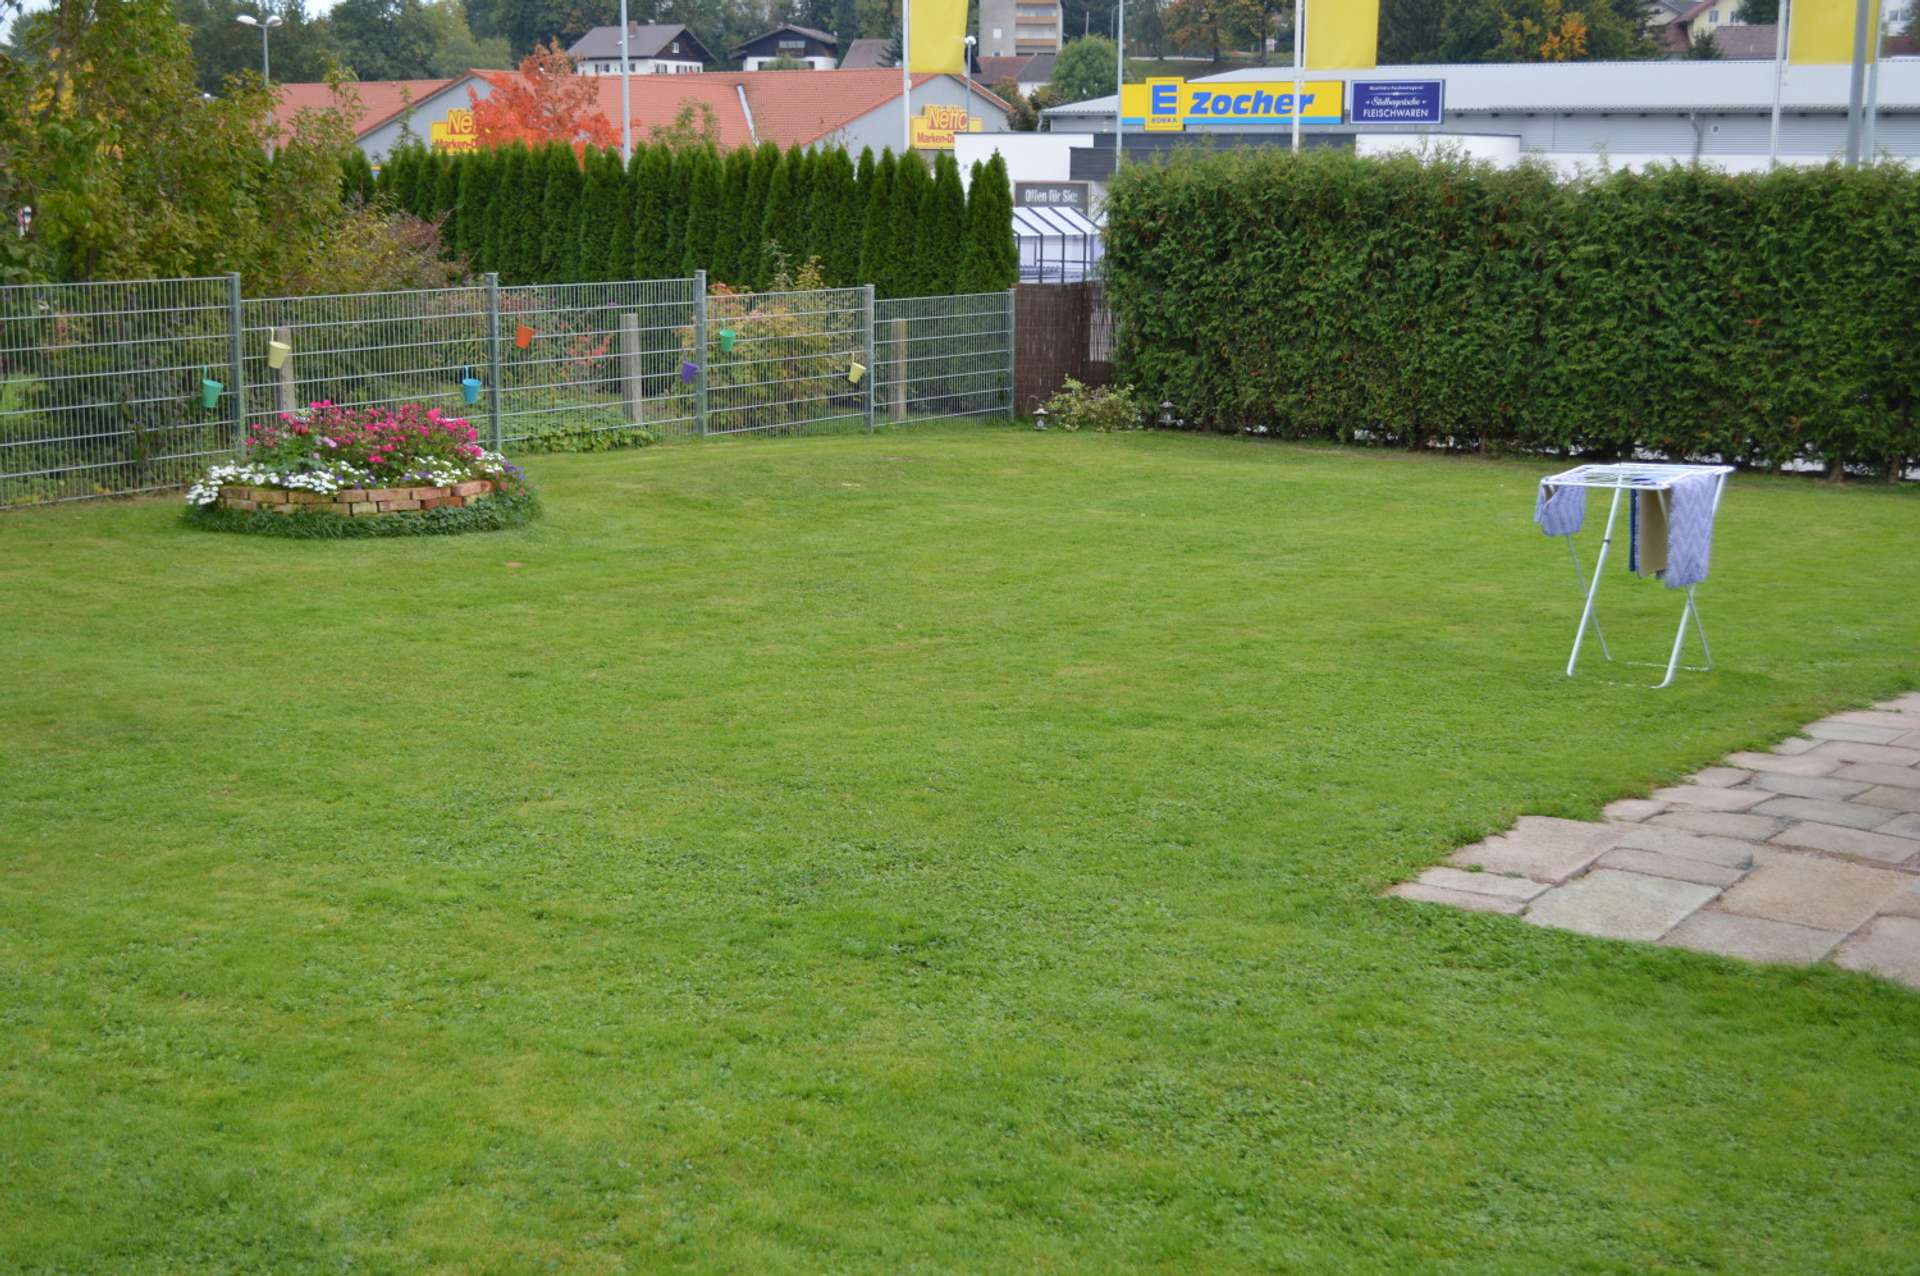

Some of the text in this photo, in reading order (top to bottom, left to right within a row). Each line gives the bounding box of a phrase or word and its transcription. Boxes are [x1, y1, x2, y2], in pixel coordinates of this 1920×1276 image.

[1152, 85, 1177, 114] E
[1189, 90, 1315, 114] Zocher
[1363, 108, 1429, 118] FLEISCHWAREN
